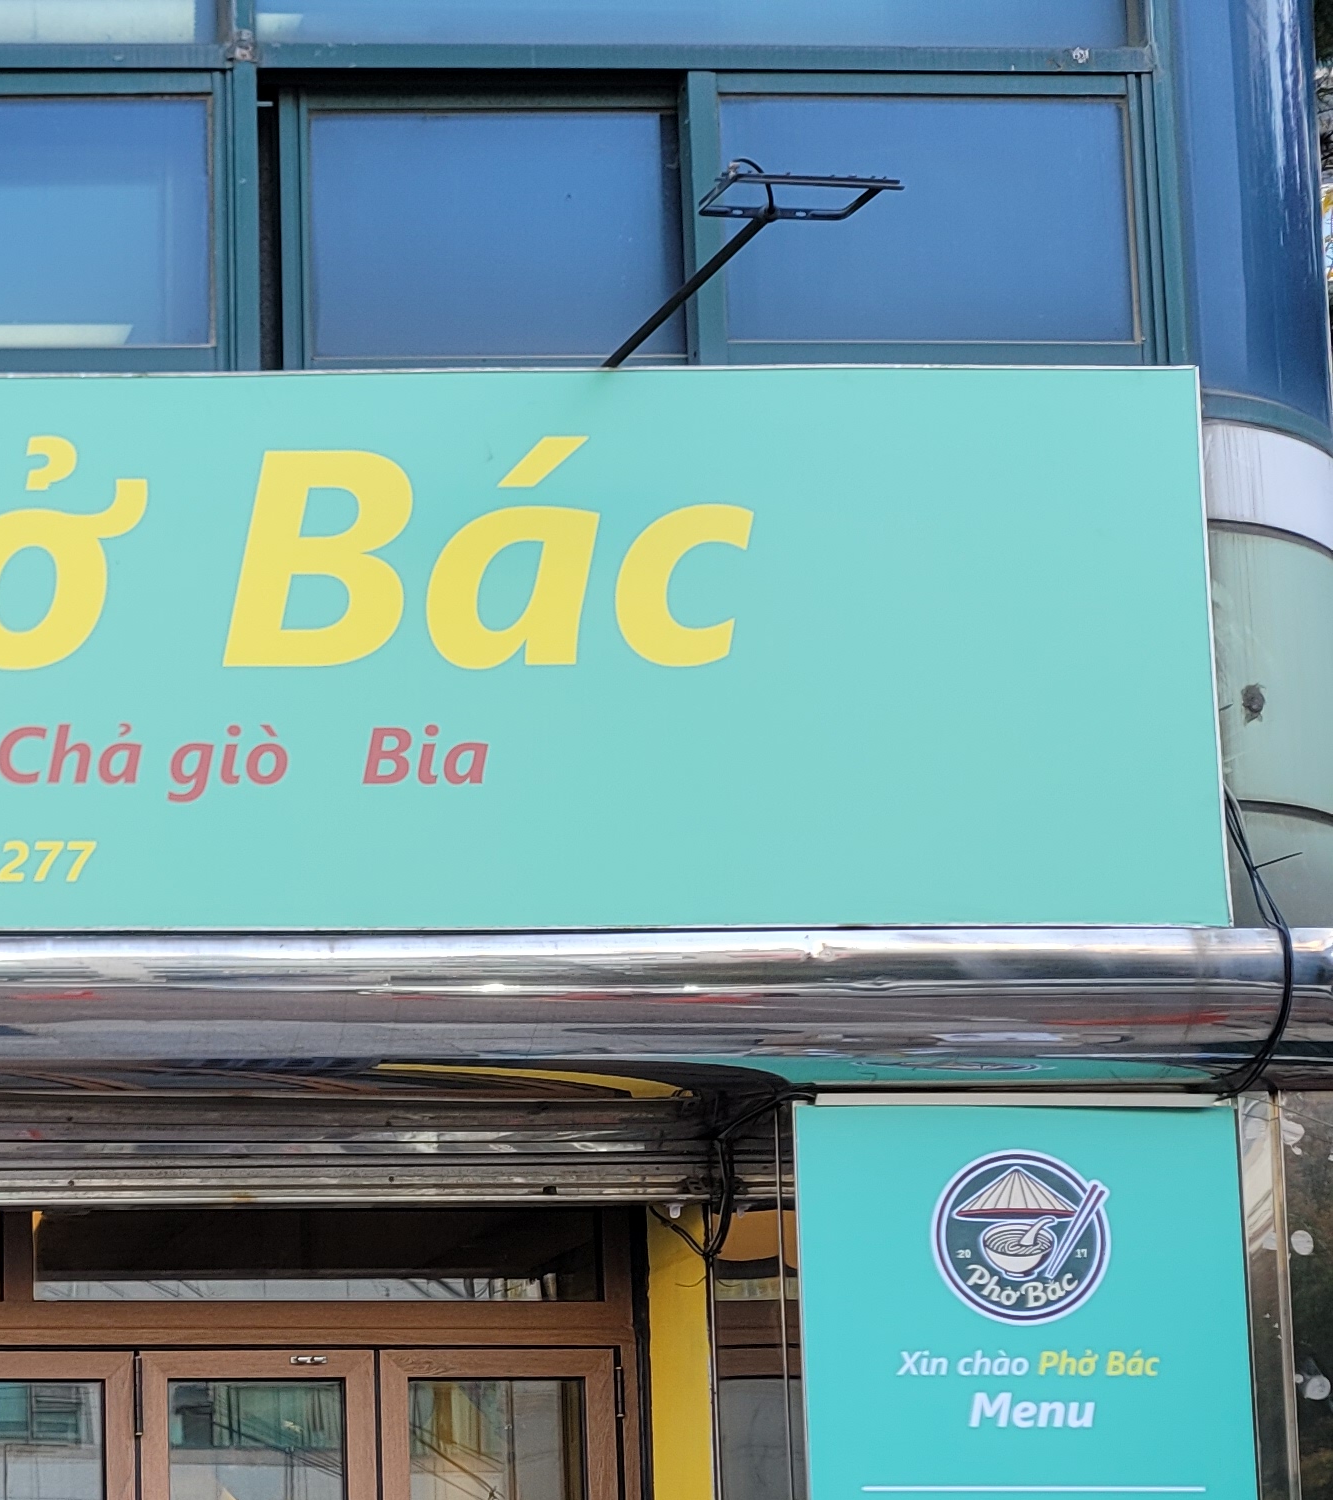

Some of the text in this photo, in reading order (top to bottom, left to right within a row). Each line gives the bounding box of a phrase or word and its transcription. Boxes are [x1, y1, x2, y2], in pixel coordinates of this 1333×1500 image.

[224, 437, 752, 669] Bác
[168, 725, 288, 802] giò
[363, 724, 488, 784] Bia
[956, 1248, 1087, 1258] 20 17
[896, 1349, 1160, 1377] Xin chào Phở Bác
[969, 1392, 1095, 1428] Menu
